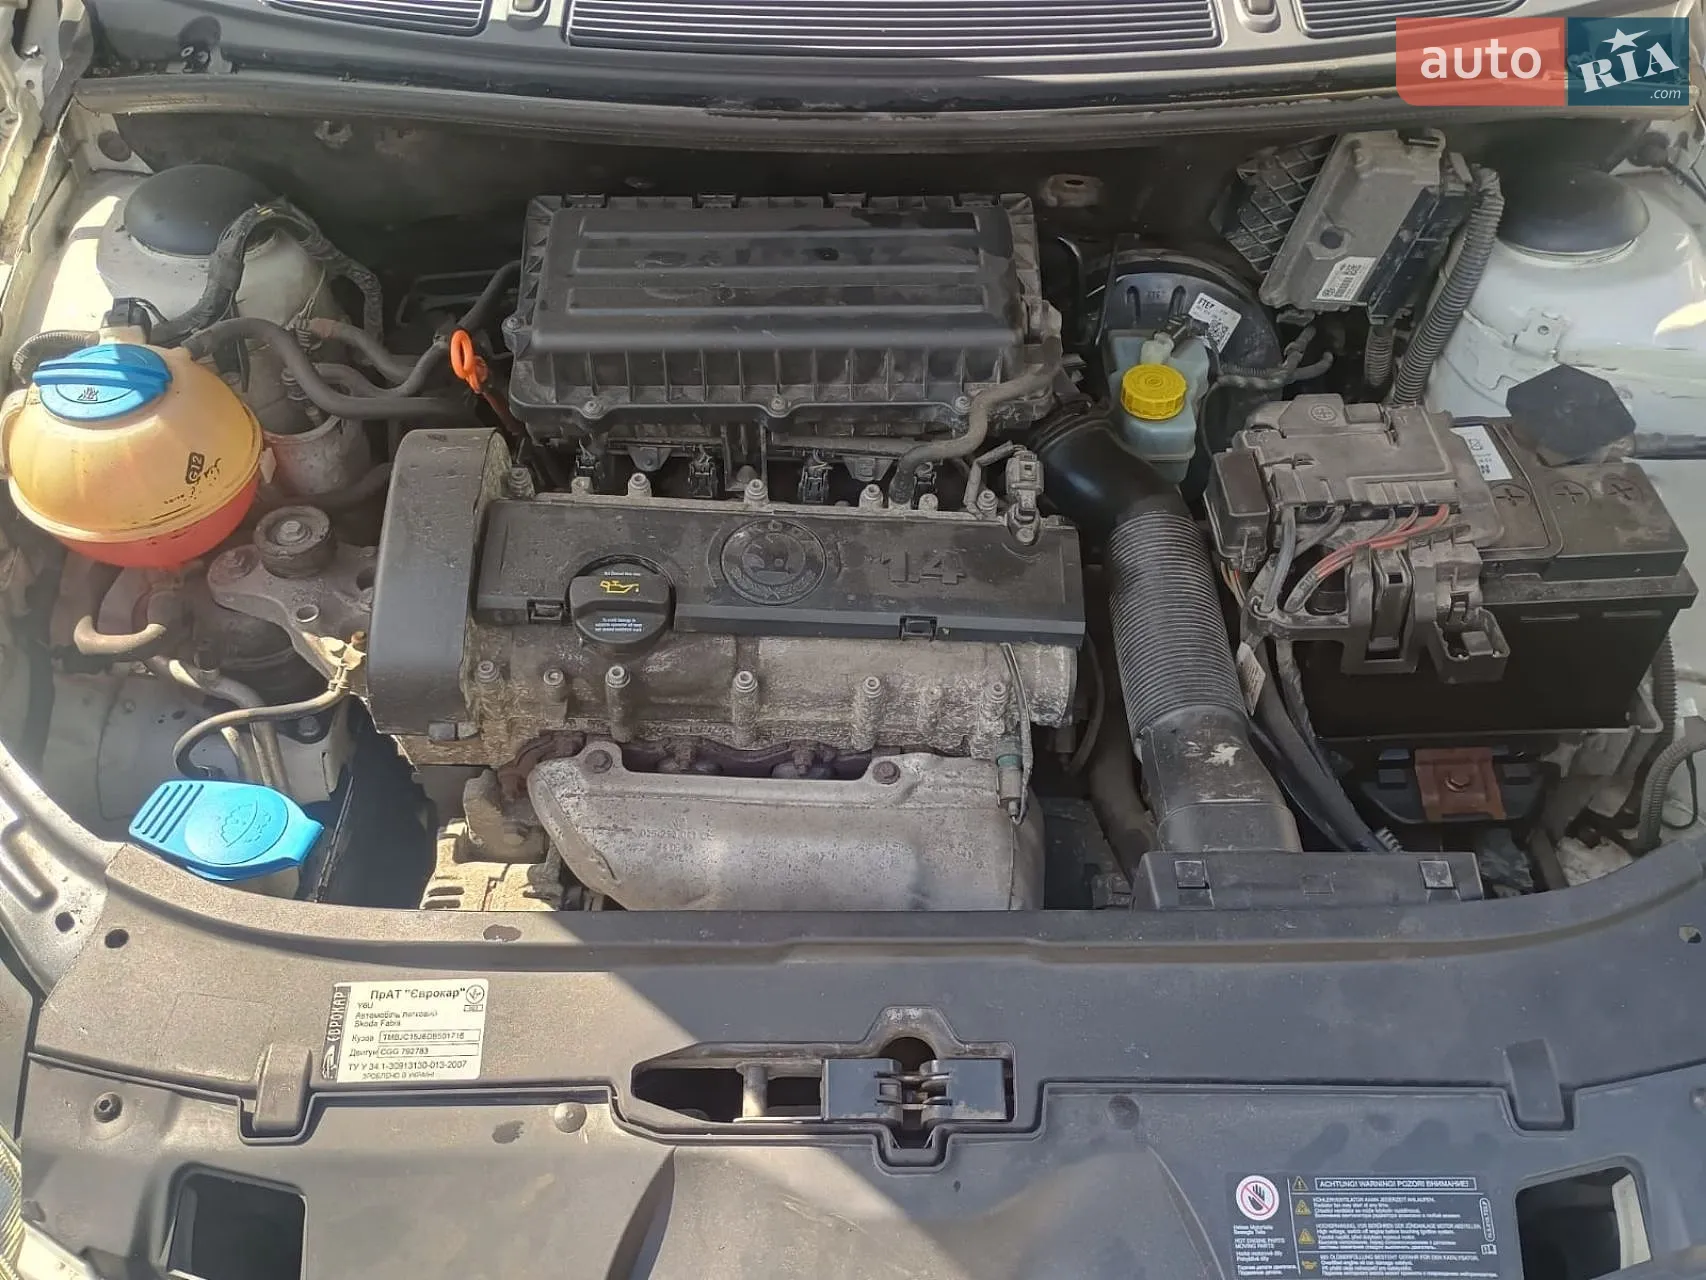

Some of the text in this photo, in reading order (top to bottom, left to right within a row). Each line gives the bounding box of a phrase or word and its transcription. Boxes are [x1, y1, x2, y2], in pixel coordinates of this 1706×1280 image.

[370, 987, 466, 1000] ПрАТ "Єврокар"
[327, 991, 347, 1042] ЄВРОКАР
[354, 1020, 378, 1028] Skoda
[352, 1034, 374, 1044] Кузов
[349, 1048, 378, 1057] Двигун
